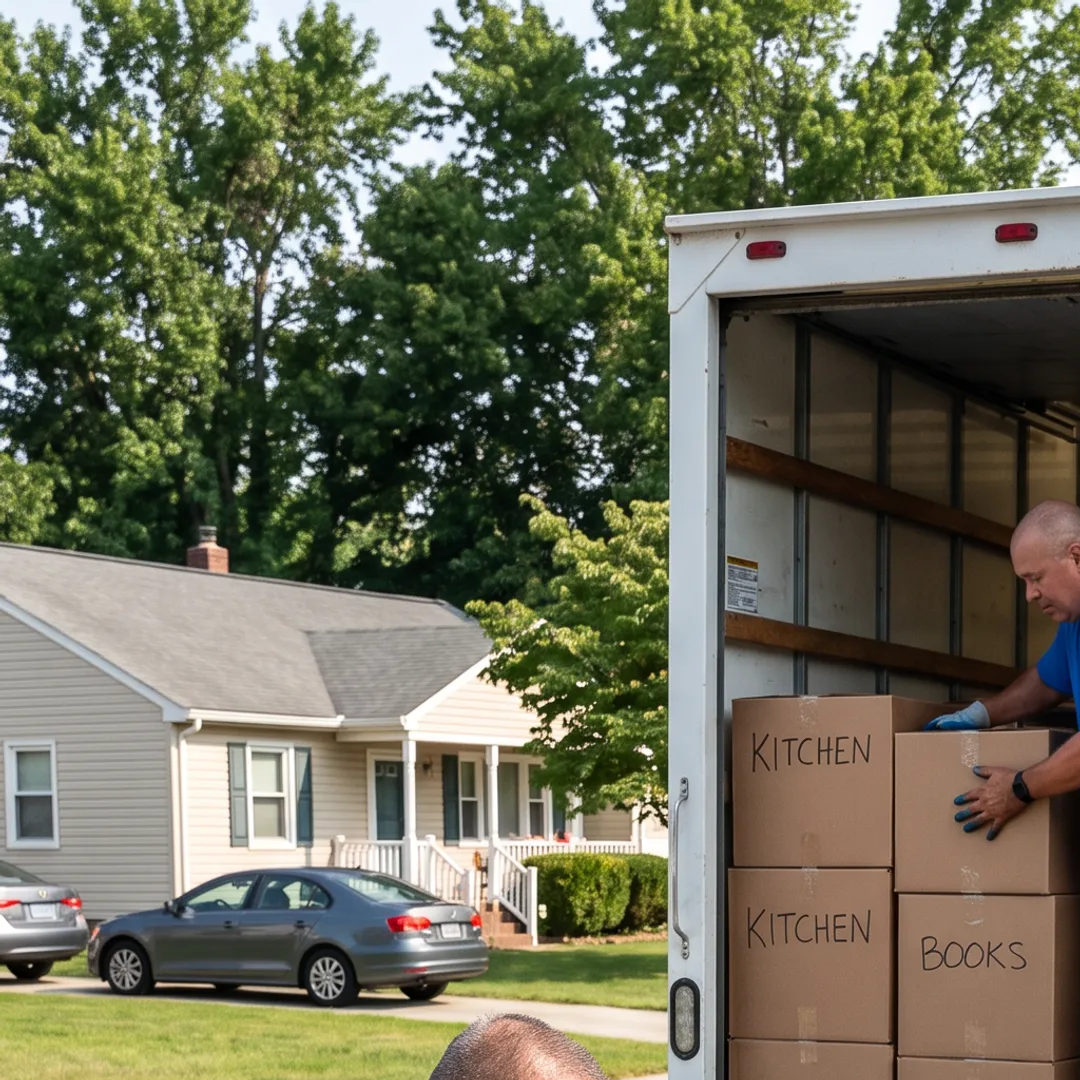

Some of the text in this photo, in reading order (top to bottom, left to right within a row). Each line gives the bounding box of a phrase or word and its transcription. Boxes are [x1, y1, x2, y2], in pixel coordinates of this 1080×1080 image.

[752, 732, 871, 773] KITCHEN
[747, 907, 871, 949] KITCHEN
[921, 936, 1027, 971] BOOKS
